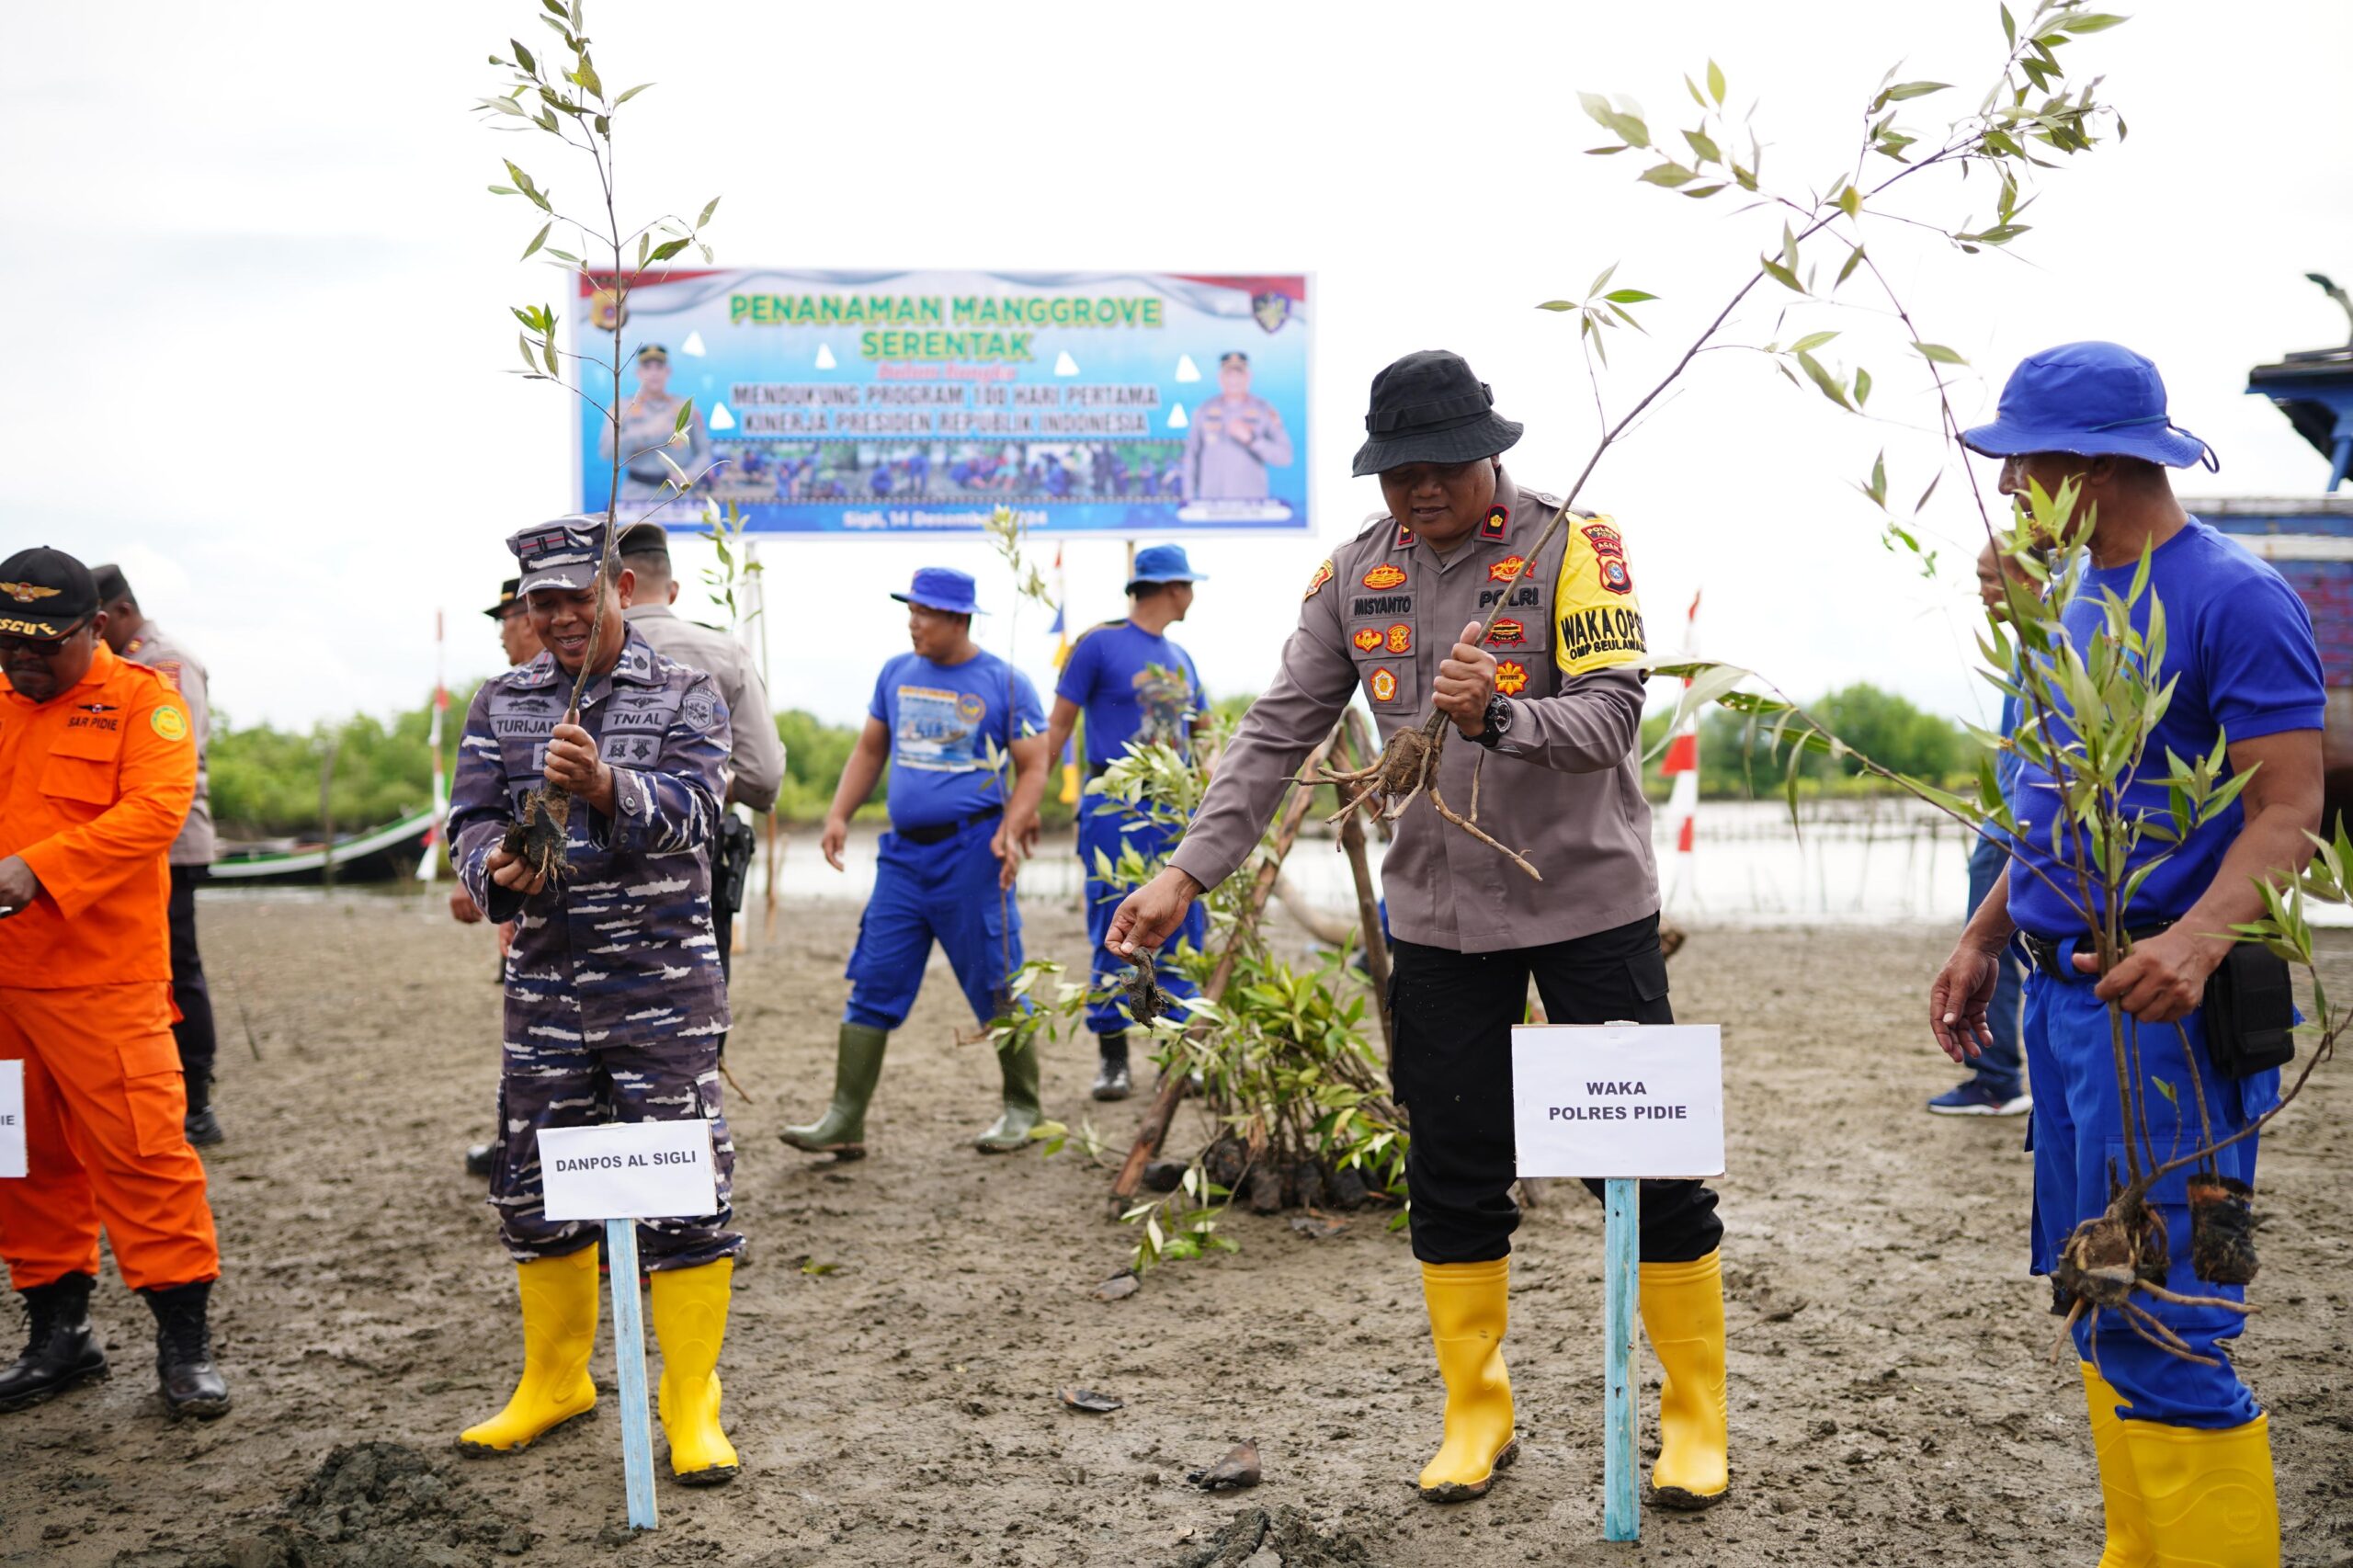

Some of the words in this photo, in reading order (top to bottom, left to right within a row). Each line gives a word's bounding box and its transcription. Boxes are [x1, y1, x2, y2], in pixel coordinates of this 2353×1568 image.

[731, 294, 942, 324] PENANAMAN
[951, 295, 1162, 325] MANGGROVE
[861, 330, 1034, 360] SERENTAK
[733, 383, 859, 405] MENDUKUNG
[867, 383, 963, 405] PROGRAM
[1013, 384, 1061, 405] HARI
[1065, 385, 1159, 406] PERTAMA
[745, 412, 827, 434] KINERJA
[835, 412, 933, 434] PRESIDEN
[938, 412, 1032, 434] REPUBLIK
[1039, 412, 1148, 434] INDONESIA
[1354, 596, 1412, 616] MISYANTO
[1479, 587, 1539, 608] POLRI
[1561, 608, 1615, 650] WAKA
[1570, 644, 1592, 660] OMP
[68, 717, 89, 727] SAR
[90, 717, 118, 732] PIDIE
[496, 720, 560, 733] TURIJAN
[613, 713, 641, 725] TNI
[642, 712, 662, 725] AL
[1586, 1082, 1647, 1096] WAKA
[1549, 1106, 1627, 1120] POLRES
[1634, 1106, 1688, 1119] PIDIE
[556, 1155, 622, 1172] DANPOS
[628, 1153, 648, 1167] AL
[653, 1151, 696, 1165] SIGLI
